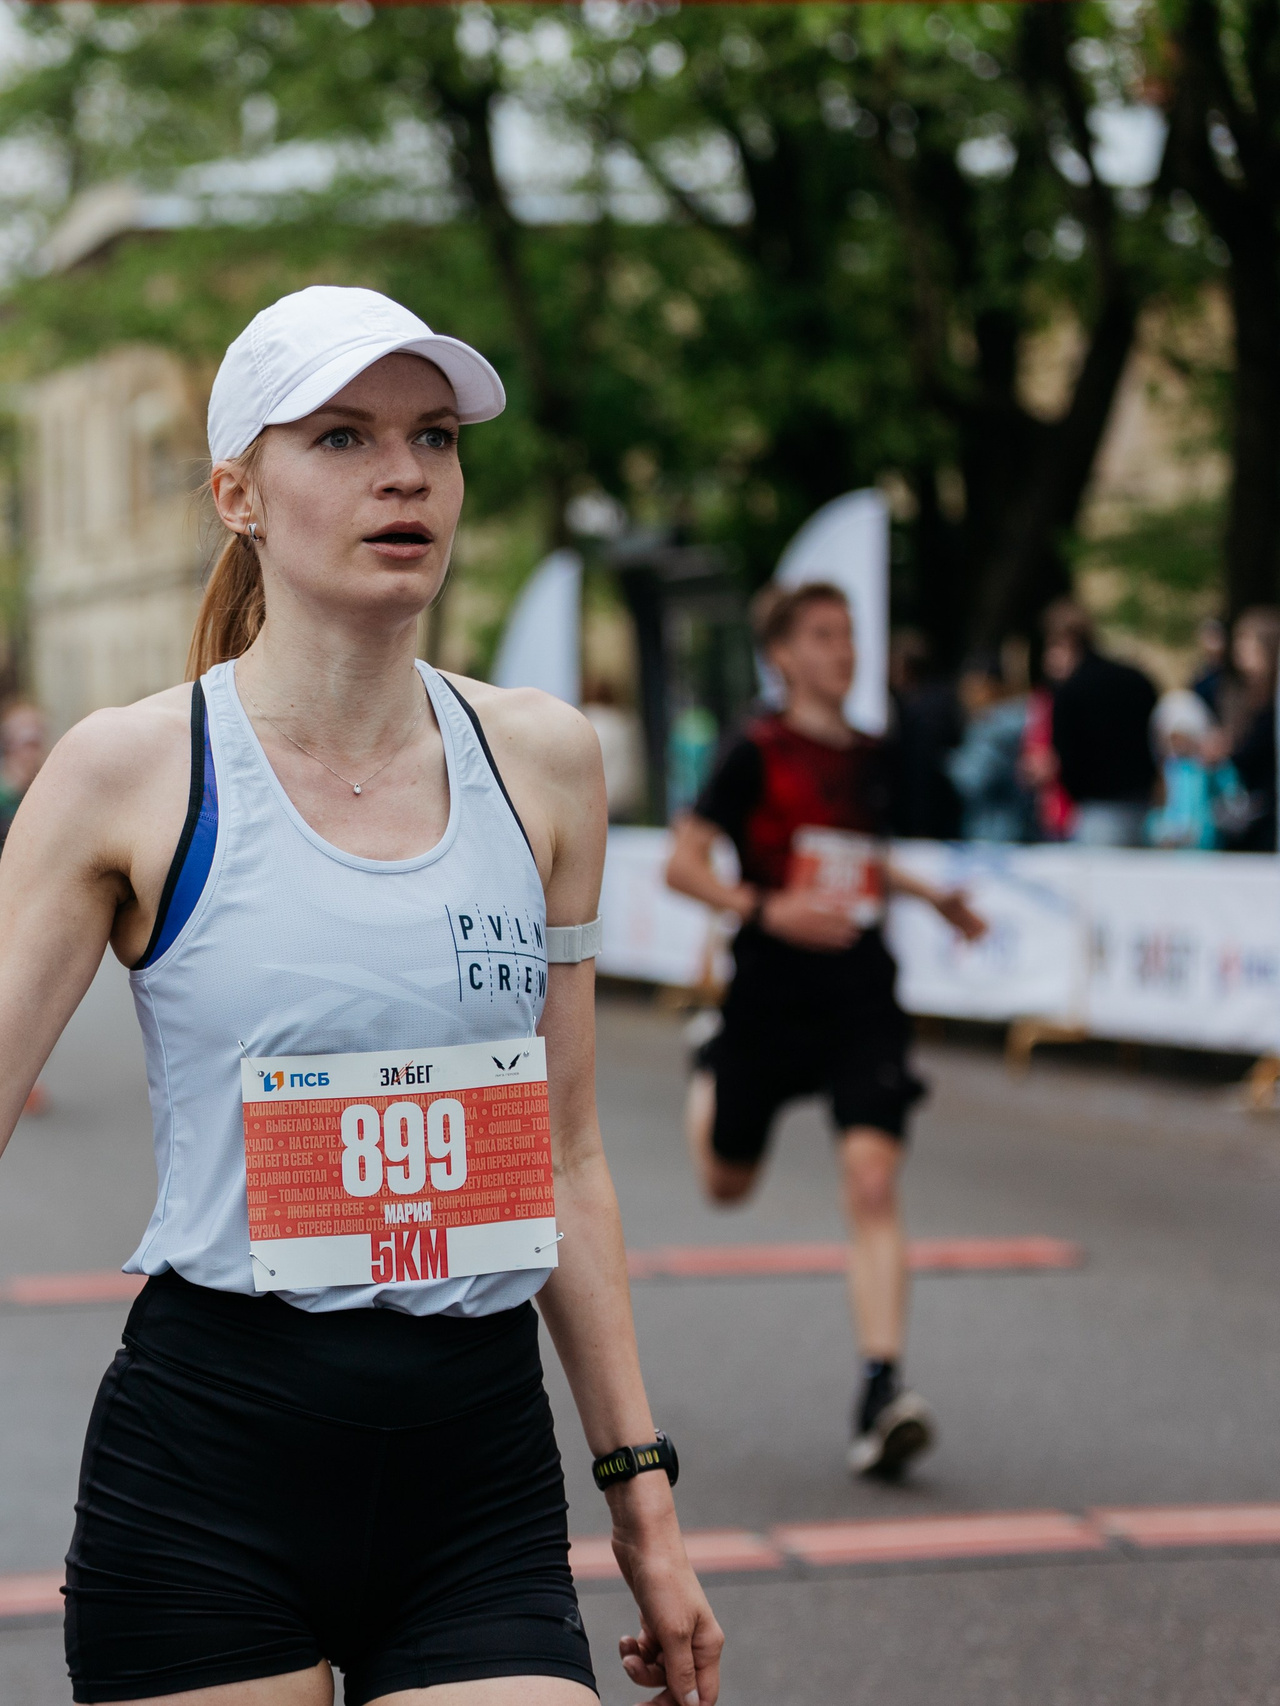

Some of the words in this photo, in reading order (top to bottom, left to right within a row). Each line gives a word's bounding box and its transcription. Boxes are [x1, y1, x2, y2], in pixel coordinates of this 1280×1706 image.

[468, 962, 547, 999] CREW
[290, 1071, 330, 1088] ПСБ
[483, 1086, 508, 1102] ЛЮБИ
[508, 1084, 523, 1099] БЕГ
[524, 1083, 531, 1098] В
[249, 1101, 308, 1117] КИЛОМЕТРЫ
[491, 1101, 523, 1117] СТРЕСС
[523, 1098, 549, 1115] ДАВН
[265, 1118, 311, 1134] ВЫБЕГАЮ
[312, 1117, 325, 1131] ЗА
[488, 1119, 522, 1135] ФИНИШ
[289, 1136, 301, 1150] НА
[302, 1134, 337, 1149] СТАРТЕ
[340, 1097, 468, 1198] 899
[475, 1139, 496, 1154] ПОКА
[496, 1137, 513, 1151] ВСЕ
[513, 1135, 536, 1149] СПЯТ
[265, 1153, 282, 1168] БЕГ
[282, 1152, 290, 1167] В
[290, 1152, 314, 1166] СЕБЕ
[487, 1151, 550, 1170] ПЕРЕЗАГРУЗКА
[260, 1171, 291, 1187] ДАВНО
[292, 1169, 328, 1184] ОТСТАЛ
[482, 1173, 505, 1188] ВСЕМ
[505, 1169, 545, 1186] СЕРДЦЕМ
[278, 1188, 316, 1203] ТОЛЬКО
[316, 1186, 352, 1200] НАЧАЛ
[437, 1188, 508, 1210] СОПРОТИВЛЕНИЙ
[520, 1187, 544, 1202] ПОКА
[249, 1207, 267, 1222] ПЯТ
[287, 1205, 315, 1220] ЛЮБИ
[316, 1203, 333, 1218] БЕГ
[333, 1203, 341, 1217] В
[341, 1202, 365, 1216] СЕБЕ
[384, 1200, 432, 1225] МАРИЯ
[461, 1210, 473, 1224] ЗА
[472, 1207, 500, 1223] РАМКИ
[515, 1202, 554, 1218] БЕГОВАЯ
[297, 1220, 332, 1236] СТРЕСС
[333, 1218, 365, 1235] ДАВНО
